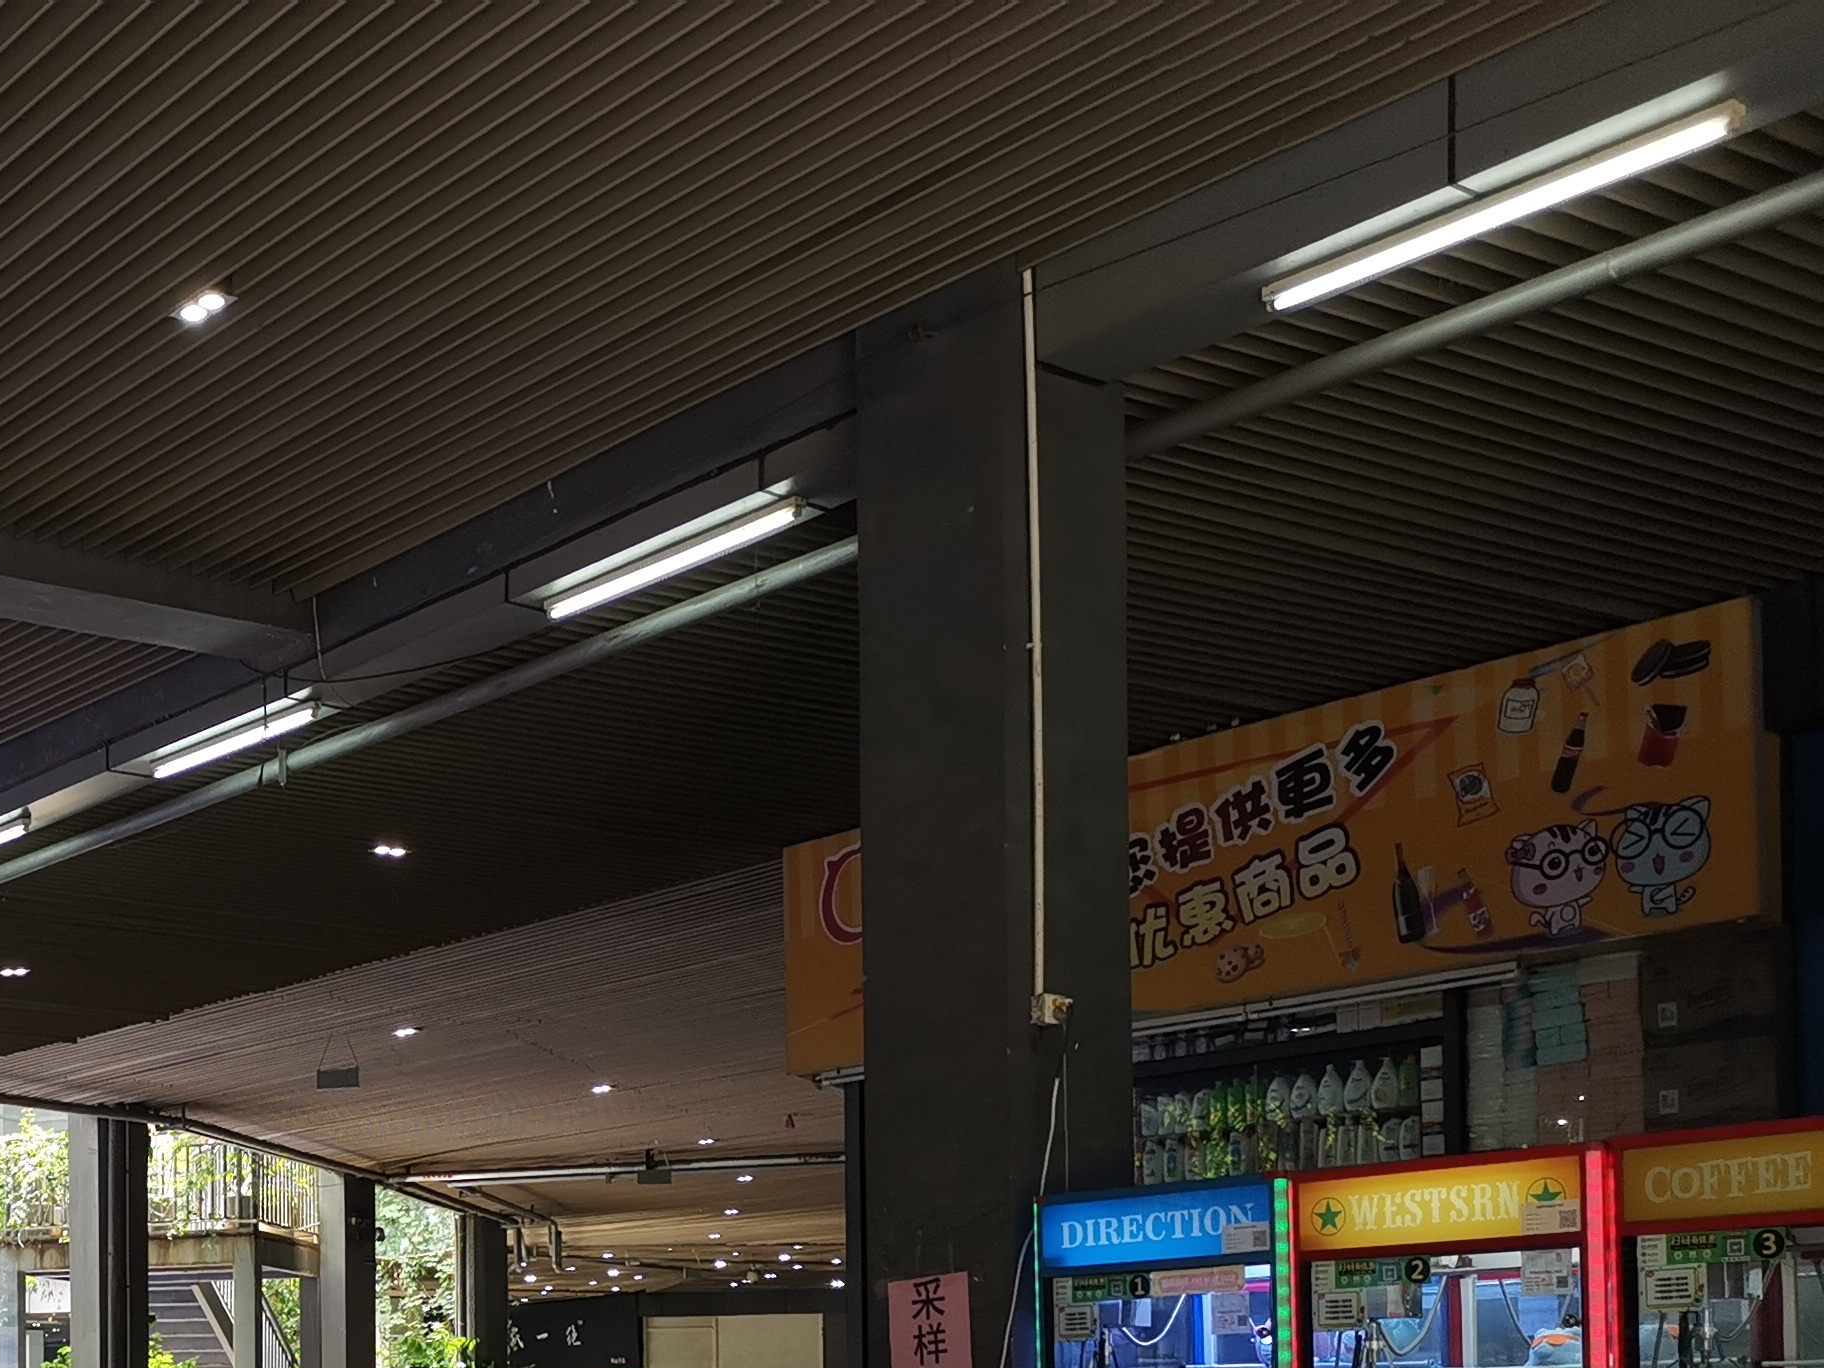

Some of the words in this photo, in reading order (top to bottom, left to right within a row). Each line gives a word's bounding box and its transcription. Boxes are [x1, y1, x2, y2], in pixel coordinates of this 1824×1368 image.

[1130, 825, 1360, 969] 优惠商品
[1645, 1151, 1812, 1204] COFFEE
[1061, 1202, 1254, 1250] DIRECTION
[1348, 1181, 1520, 1231] WESTSRN
[1761, 1232, 1776, 1255] 3
[1133, 1277, 1146, 1295] 1
[1410, 1259, 1425, 1280] 2
